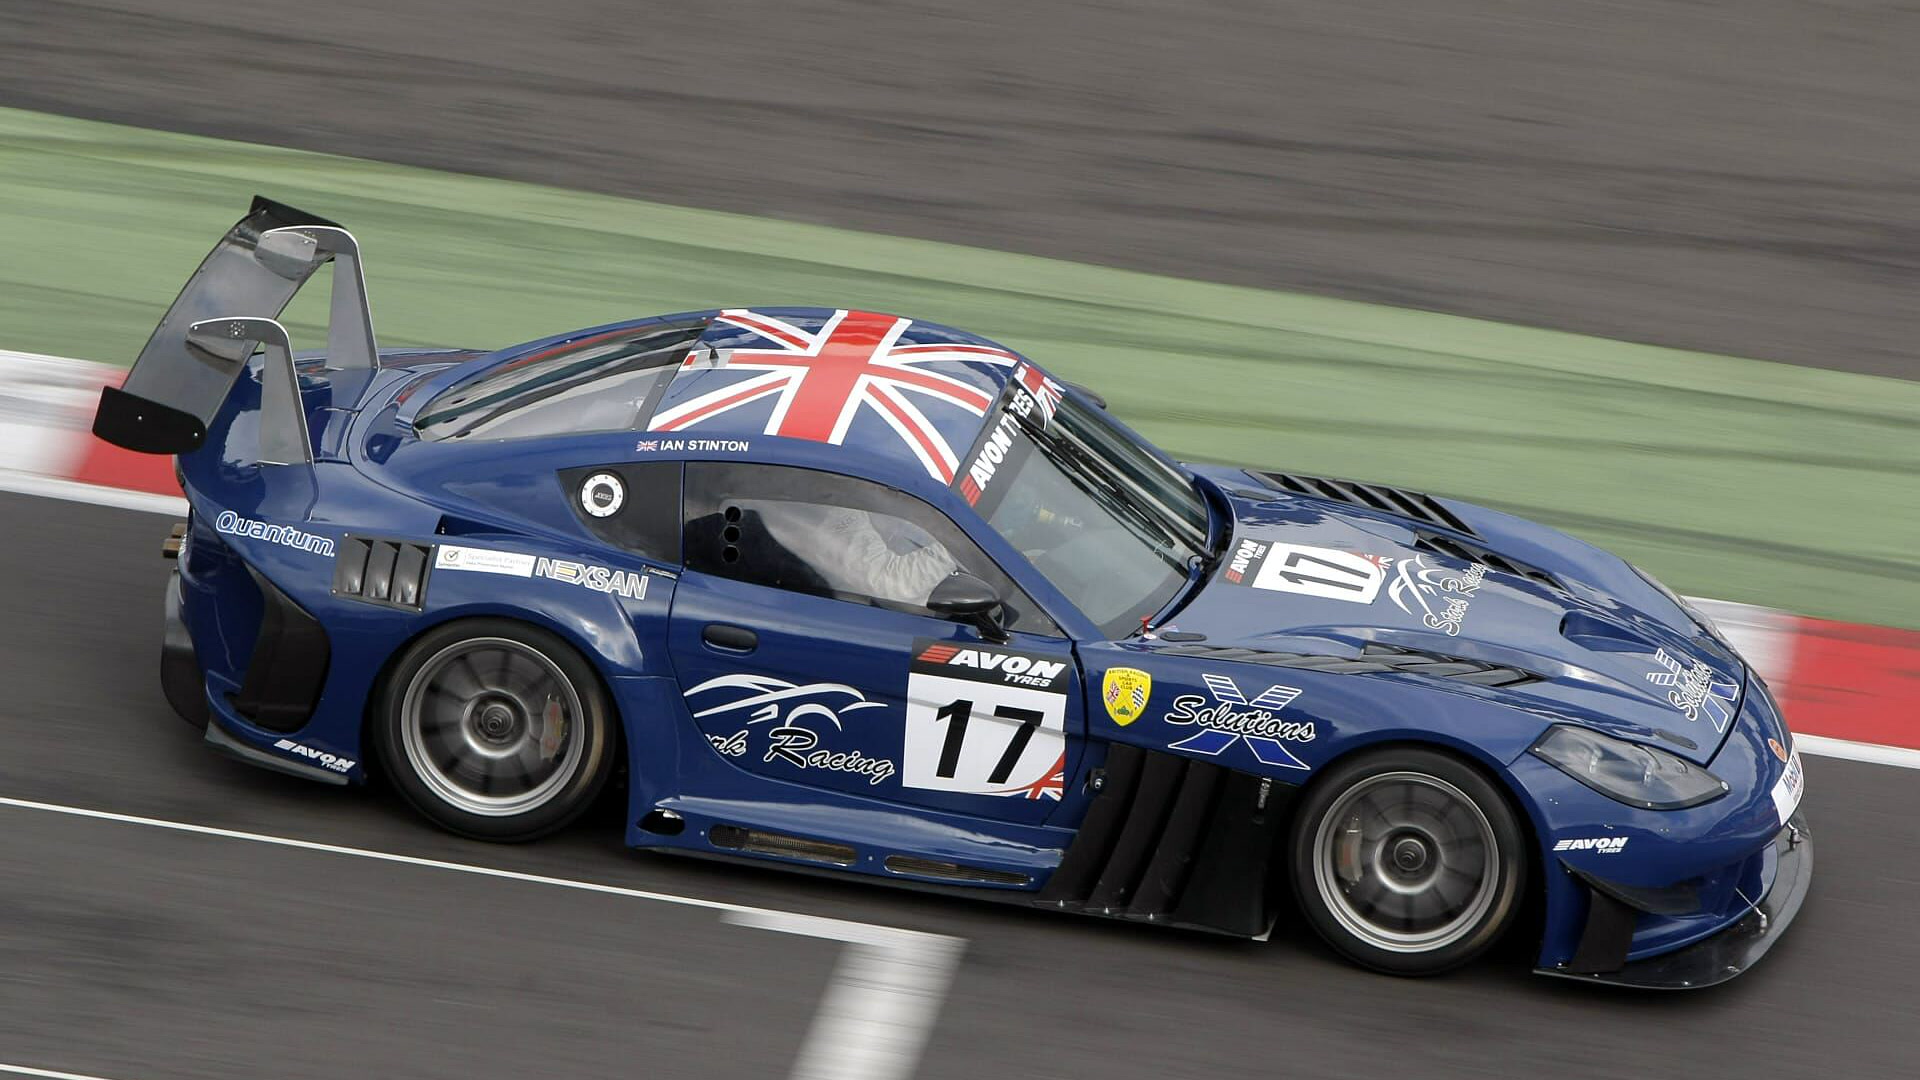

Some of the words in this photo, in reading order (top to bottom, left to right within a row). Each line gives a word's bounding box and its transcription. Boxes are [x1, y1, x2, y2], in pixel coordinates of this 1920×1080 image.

[660, 440, 684, 451] IAN
[688, 440, 749, 452] STINTON
[969, 426, 1012, 492] AVON
[1000, 389, 1034, 437] TYRES
[1230, 539, 1259, 574] AVON
[1279, 552, 1371, 592] 17
[536, 557, 649, 600] NEXSAN
[949, 650, 1066, 679] AVON
[1004, 673, 1052, 687] TYRES
[1164, 695, 1316, 742] Solutions
[291, 745, 356, 769] AVON
[763, 727, 895, 785] Racing
[936, 699, 1044, 784] 17
[1569, 837, 1629, 850] AVON
